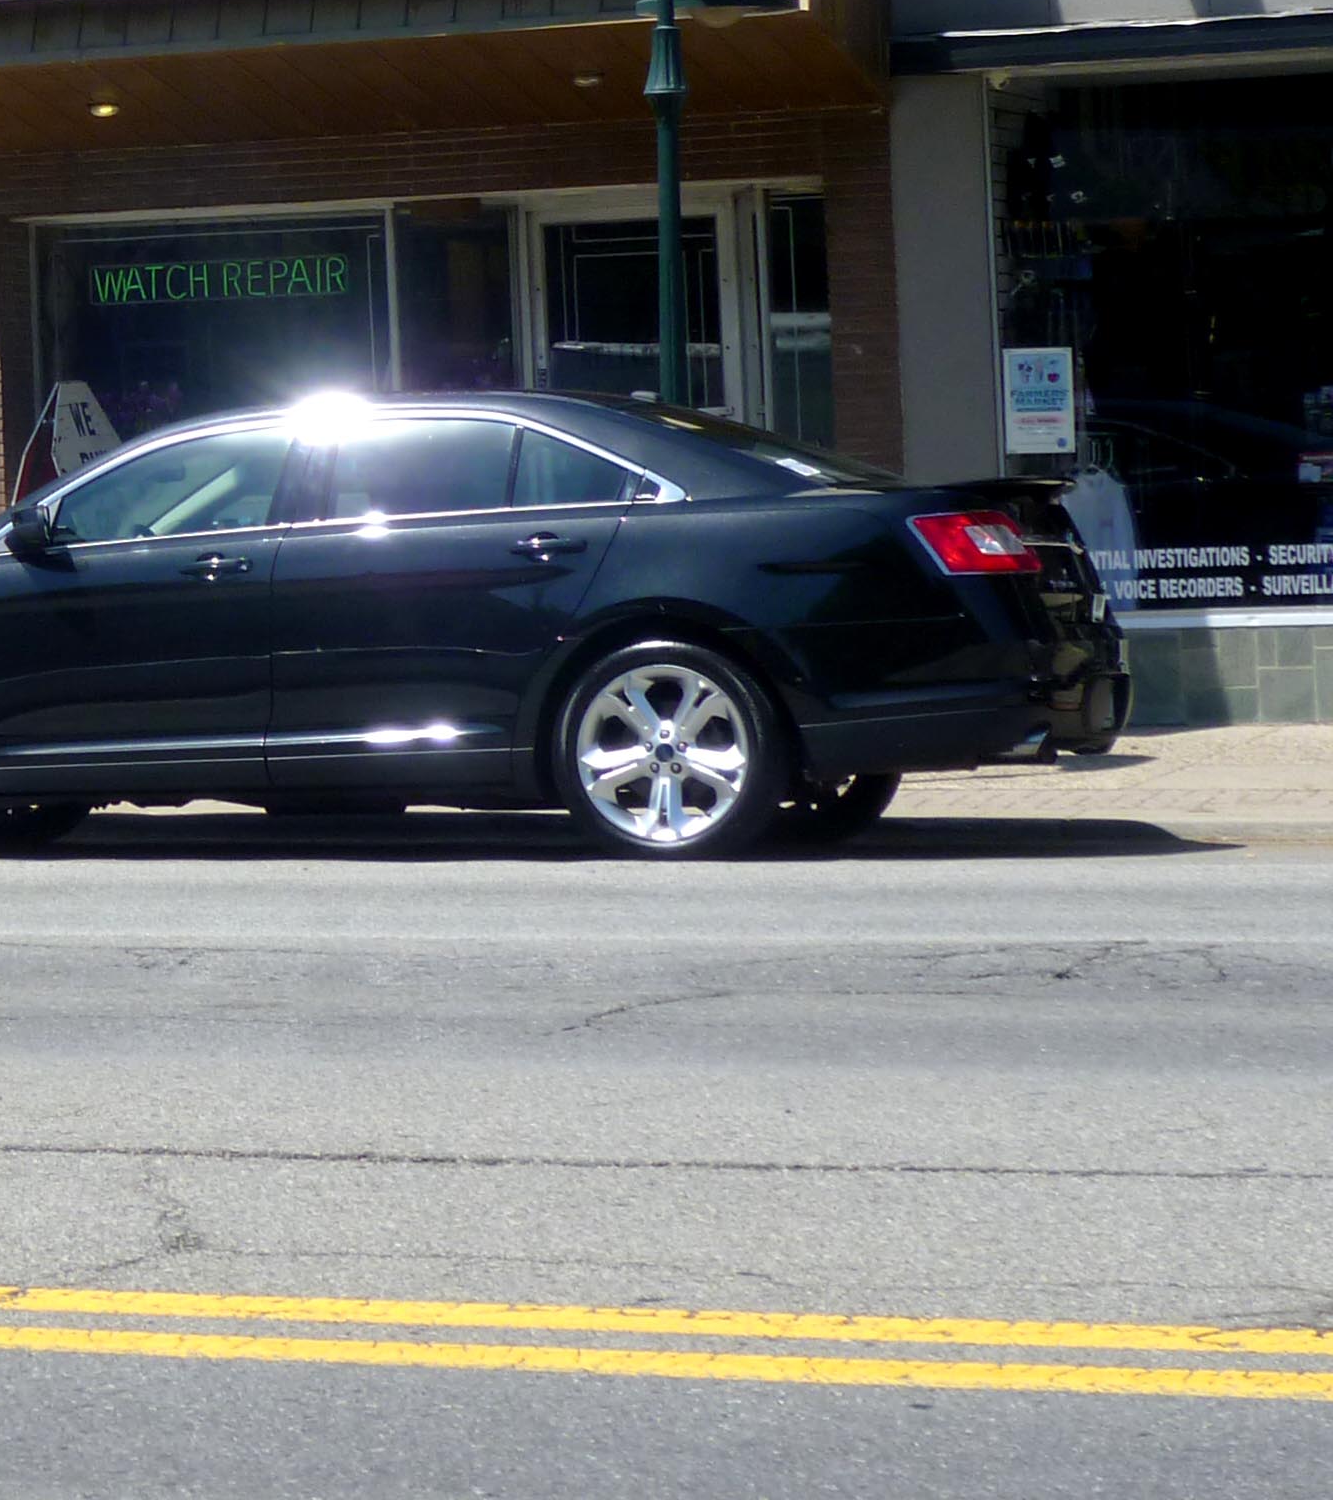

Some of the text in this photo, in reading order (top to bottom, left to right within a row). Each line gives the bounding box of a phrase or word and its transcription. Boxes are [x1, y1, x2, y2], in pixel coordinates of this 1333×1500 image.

[94, 257, 347, 302] WATCH REPAIR
[69, 402, 97, 436] WE
[1134, 546, 1250, 570] INVESTIGATIONS
[1113, 579, 1157, 600] VOICE
[1160, 576, 1243, 599] RECORDERS
[1262, 574, 1333, 597] SURVEILL
